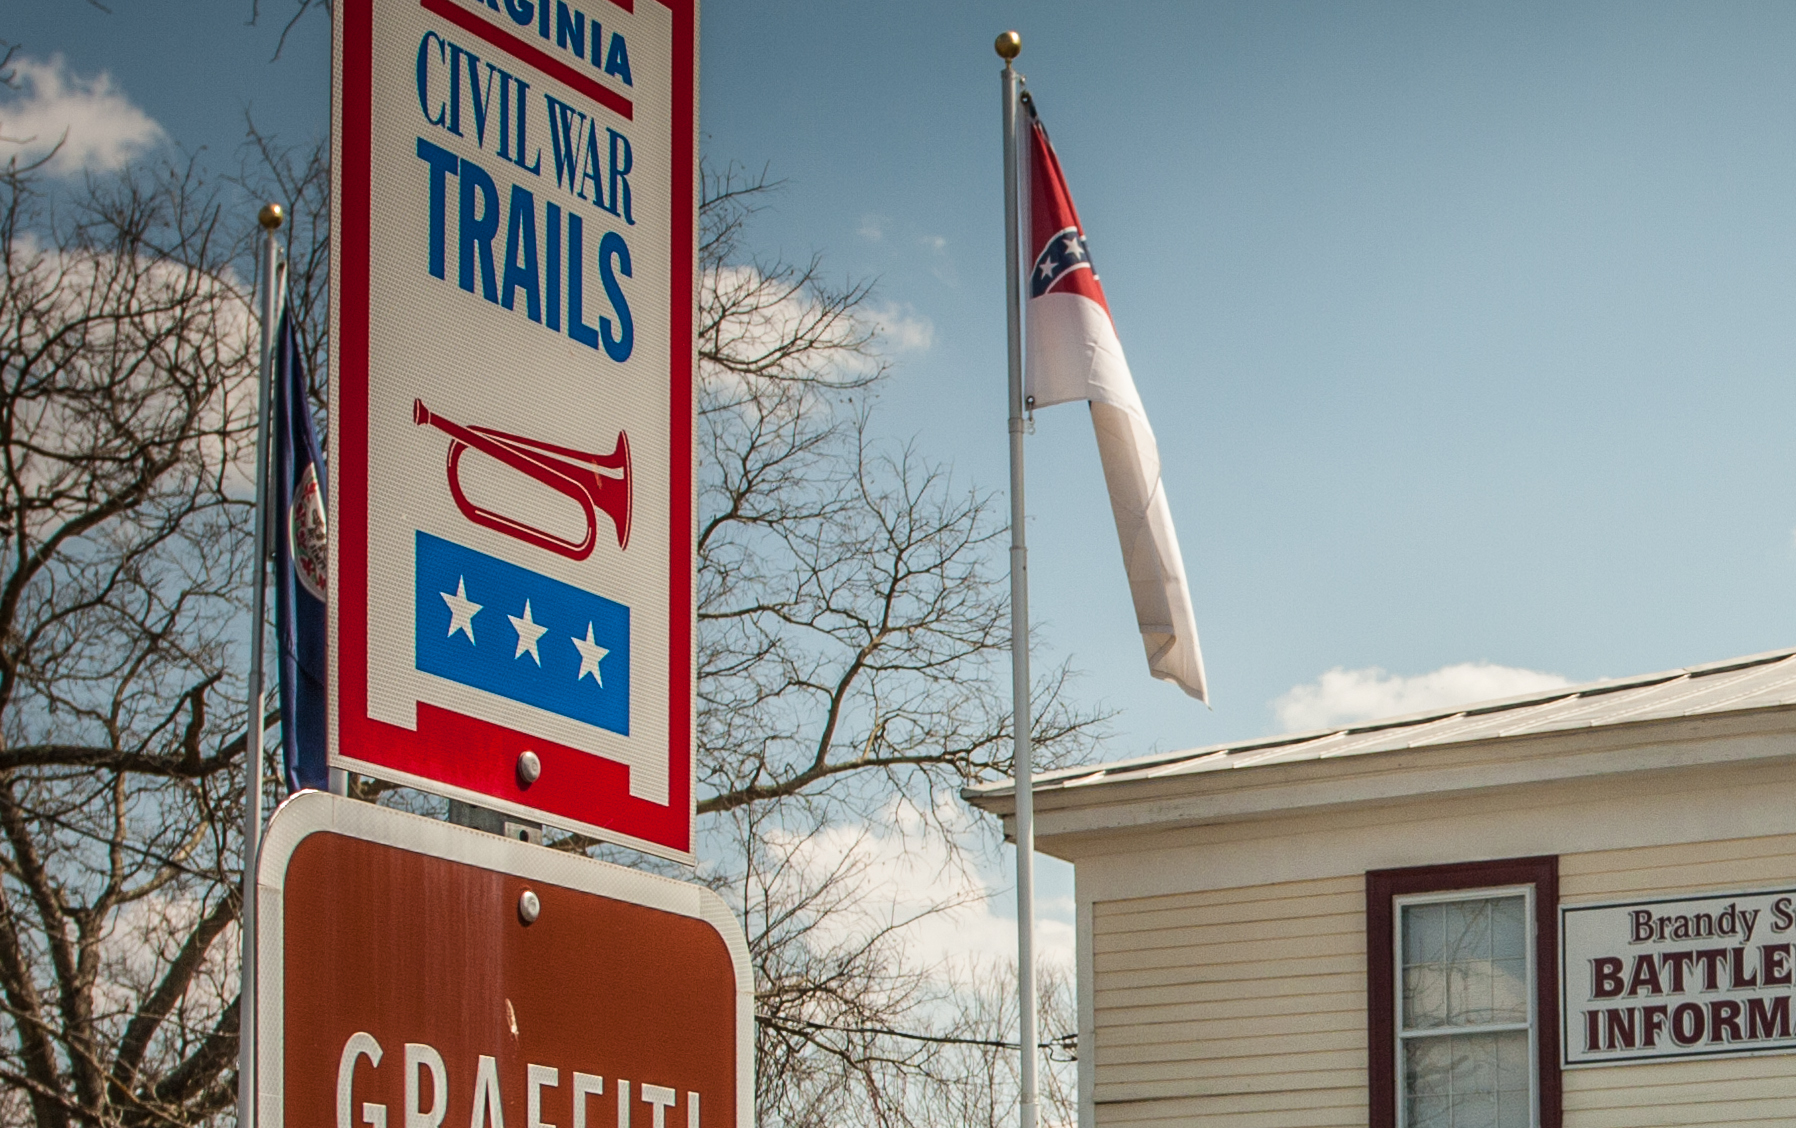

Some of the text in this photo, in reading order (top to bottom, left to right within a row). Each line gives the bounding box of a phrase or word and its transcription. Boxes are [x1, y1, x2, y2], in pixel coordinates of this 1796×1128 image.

[476, 0, 634, 88] GINIA
[416, 30, 636, 226] CIVIL WAR
[416, 136, 635, 364] TRAILS
[1628, 902, 1761, 945] Brandy
